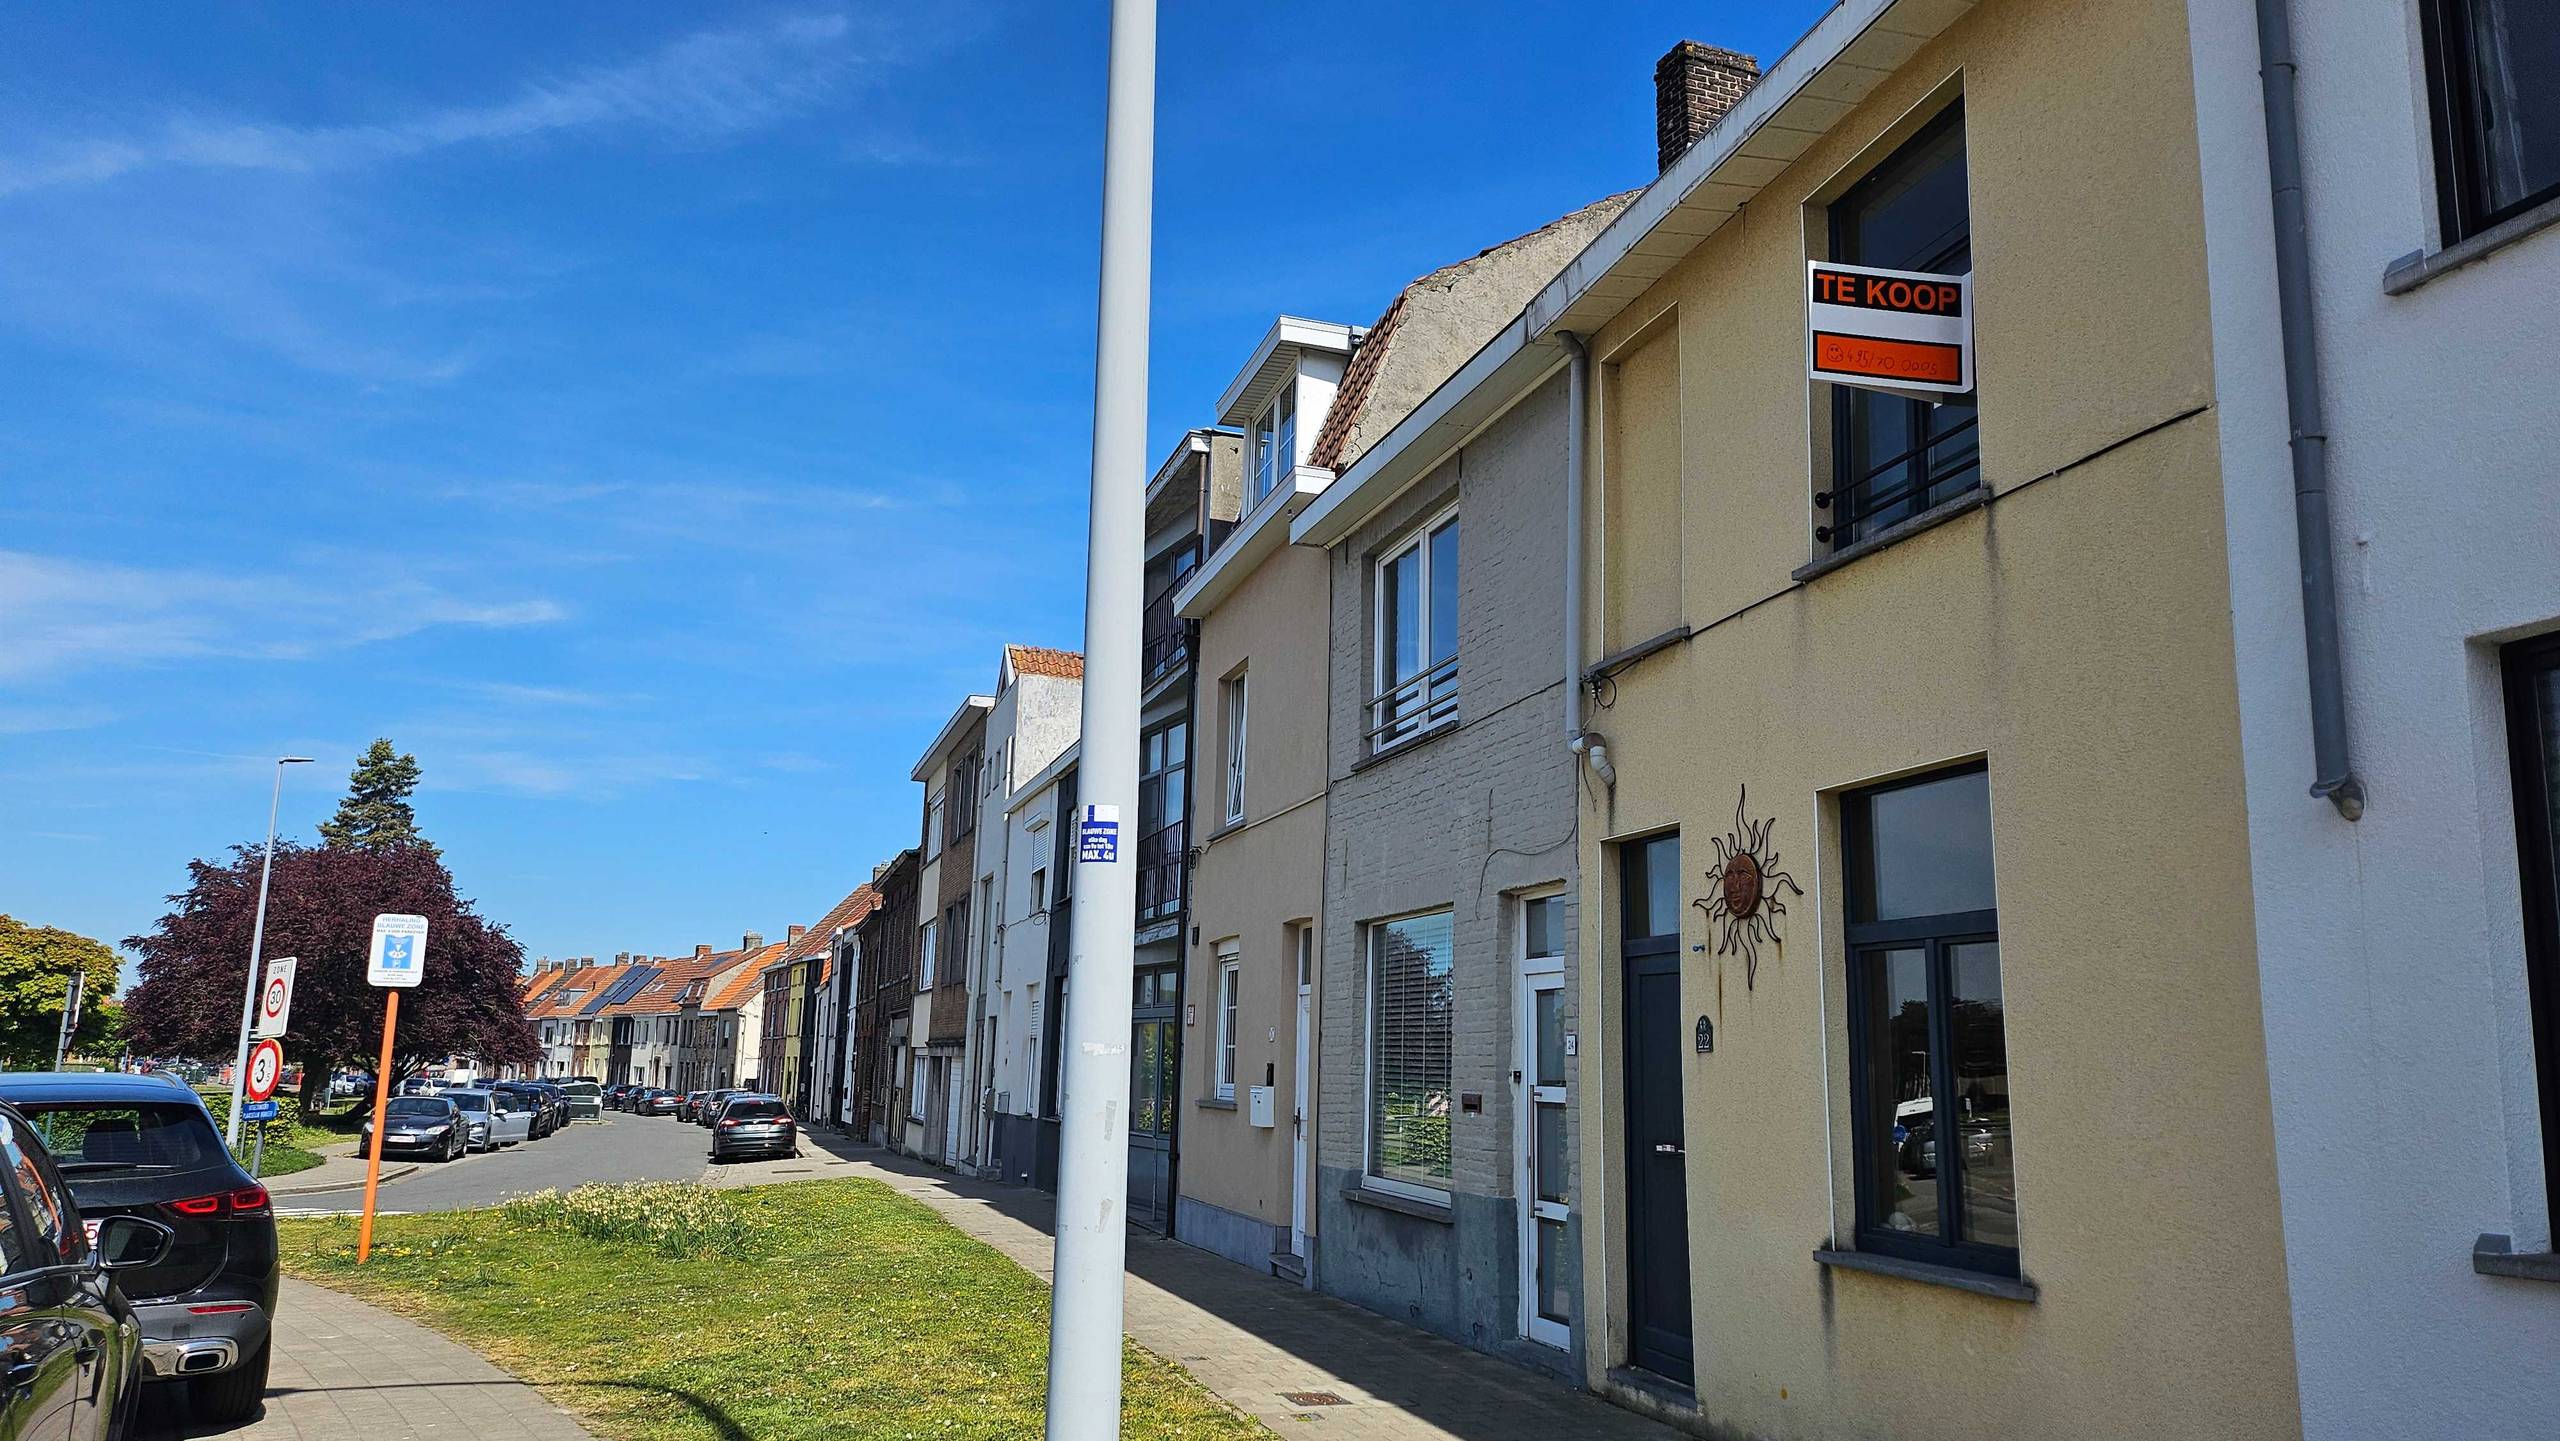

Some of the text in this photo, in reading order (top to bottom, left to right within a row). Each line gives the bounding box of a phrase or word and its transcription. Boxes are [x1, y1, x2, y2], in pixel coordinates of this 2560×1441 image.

[1816, 273, 1958, 312] TE KOOP
[1082, 850, 1102, 860] MAX.
[273, 964, 288, 975] ZONE
[270, 990, 281, 1005] 30
[1698, 1033, 1710, 1049] 22
